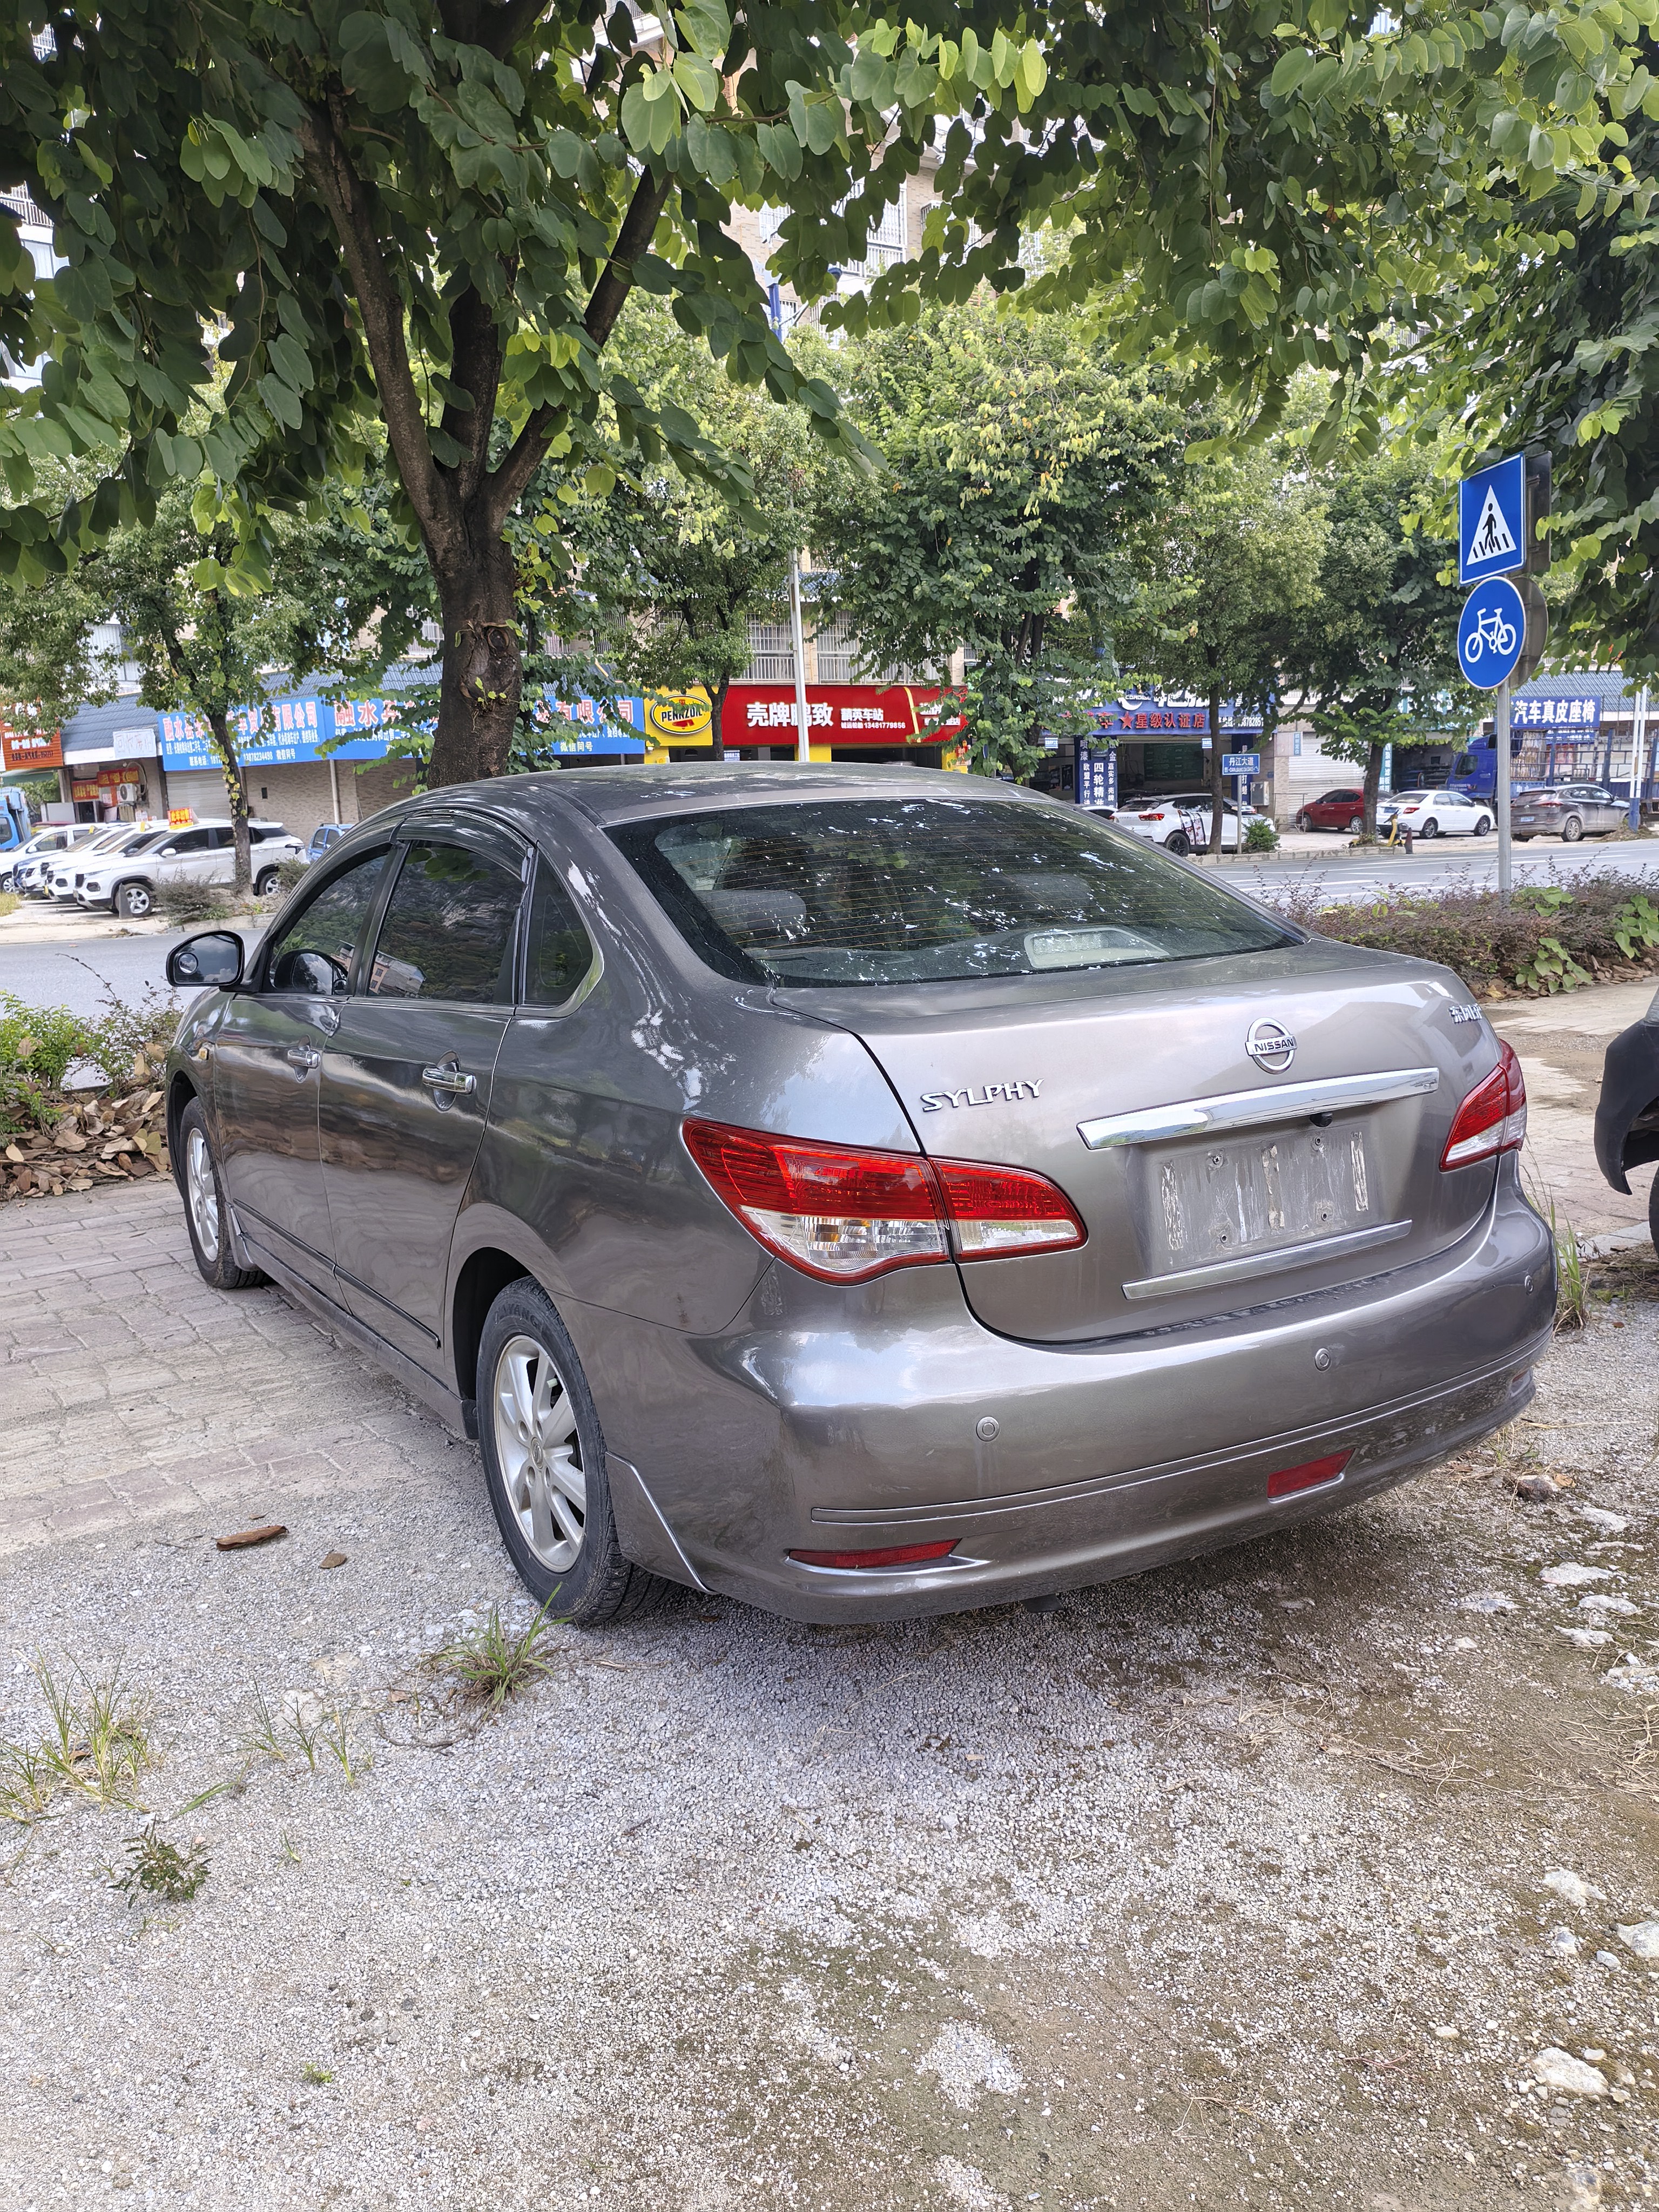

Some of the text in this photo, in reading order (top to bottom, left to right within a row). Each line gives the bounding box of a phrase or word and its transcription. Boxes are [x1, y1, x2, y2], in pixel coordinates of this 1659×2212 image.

[841, 708, 884, 721] 精英车站
[1514, 699, 1596, 724] 汽车真皮座椅
[1136, 712, 1205, 729] 星级认证店
[1229, 757, 1254, 766] 丹江大道
[1254, 1038, 1294, 1053] NISSAN
[920, 1078, 1045, 1112] SYLPHY
